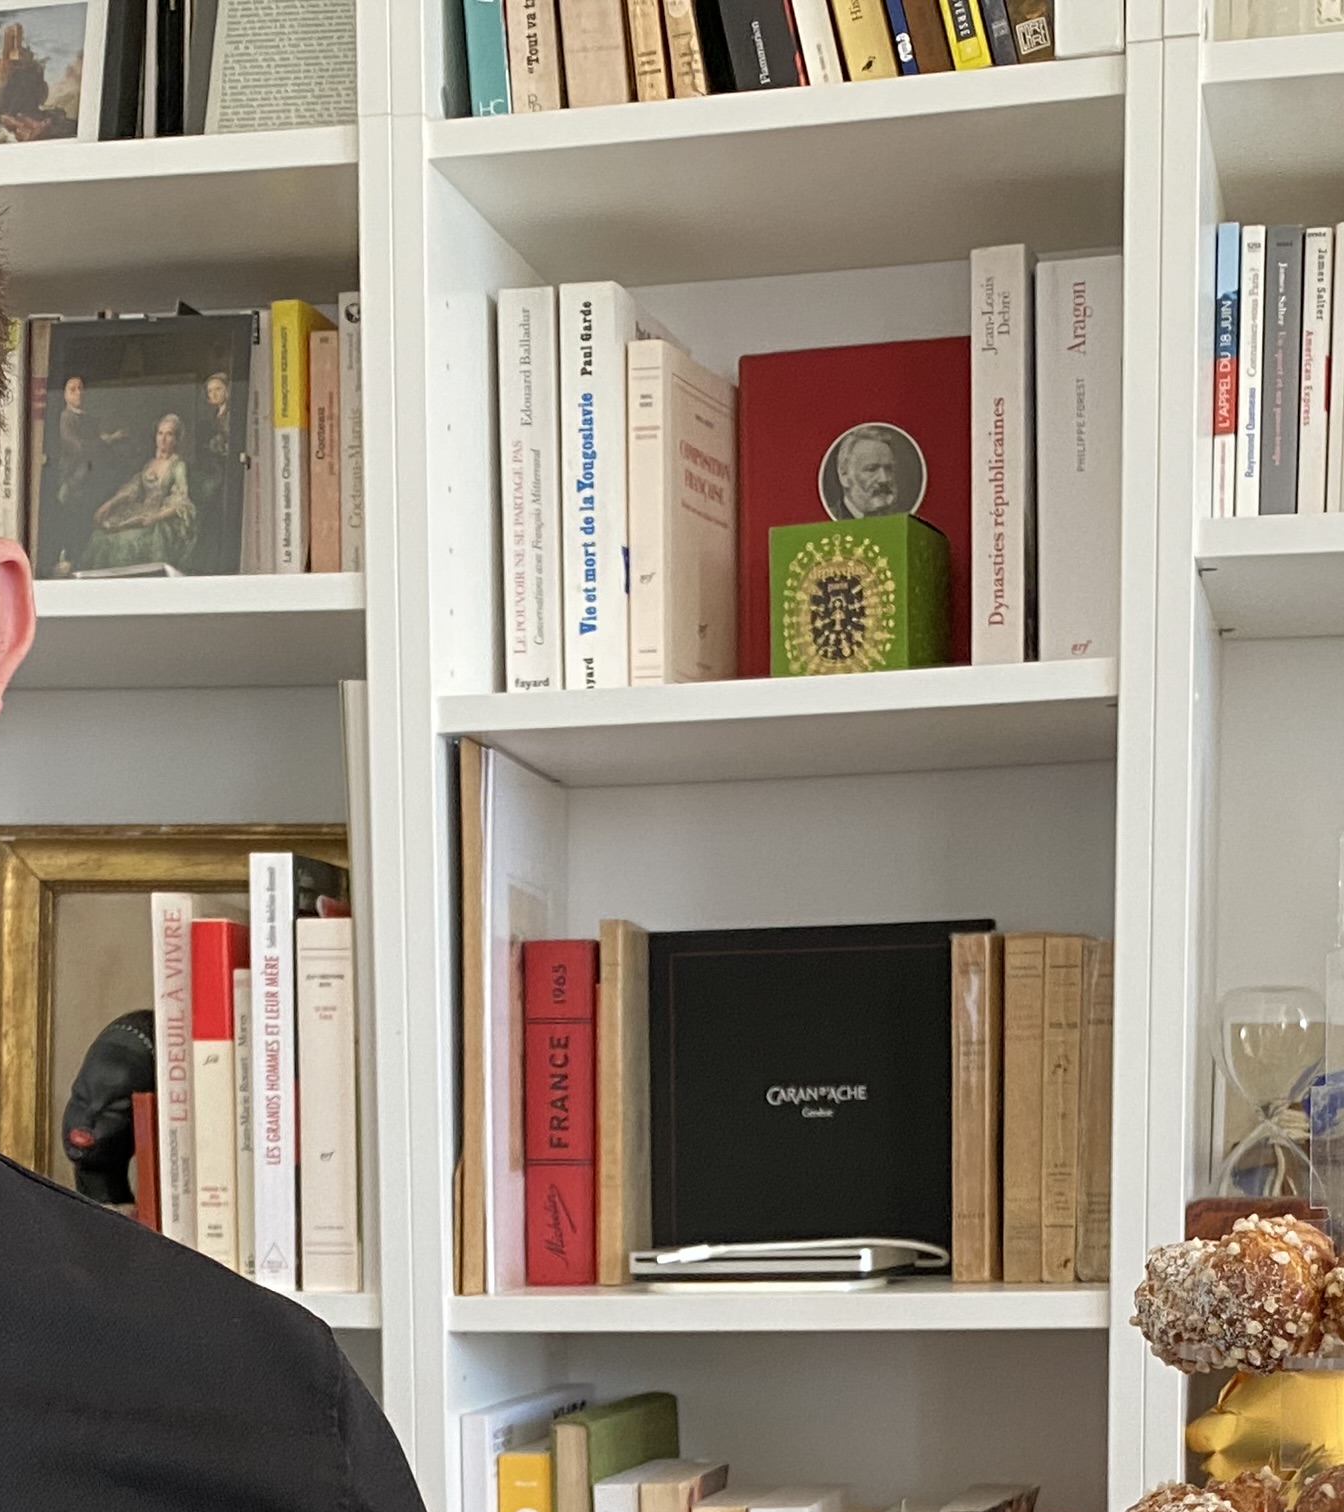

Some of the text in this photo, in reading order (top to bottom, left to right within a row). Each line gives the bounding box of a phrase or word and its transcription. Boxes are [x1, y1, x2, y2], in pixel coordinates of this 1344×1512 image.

[749, 19, 772, 85] Flammarion
[980, 277, 998, 355] Jean-Louis
[995, 290, 1012, 337] Debré
[1315, 247, 1328, 322] James Salter
[518, 307, 532, 366] Balladur
[579, 300, 593, 378] Paul Garde
[1066, 281, 1093, 355] Aragon
[1218, 299, 1233, 428] L'APPEL DU 18 JUIN
[1302, 329, 1315, 428] American Express
[315, 406, 326, 461] Cocteau
[1075, 377, 1087, 473] PHILIPPE FOREST
[1243, 432, 1256, 479] Raymond
[280, 433, 292, 563] Le Monde selon Churchill
[576, 392, 597, 636] Vie et mort de la Yougoslavie
[986, 396, 1010, 627] Dynasties républicaines
[510, 439, 526, 655] LE POUVOIR NE SE PARTAGE PAS
[162, 908, 184, 981] VIVRE
[259, 954, 280, 988] MÈRE
[160, 986, 185, 1001] À
[263, 990, 280, 1020] LEUR
[550, 964, 568, 1005] 1965
[166, 1009, 188, 1082] DEUIL
[263, 1022, 281, 1037] ET
[263, 1039, 281, 1092] HOMMES
[548, 1035, 570, 1150] FRANCE
[766, 1085, 818, 1105] CARAN
[168, 1094, 189, 1123] LE
[264, 1094, 282, 1143] GRANDS
[264, 1146, 282, 1166] LES
